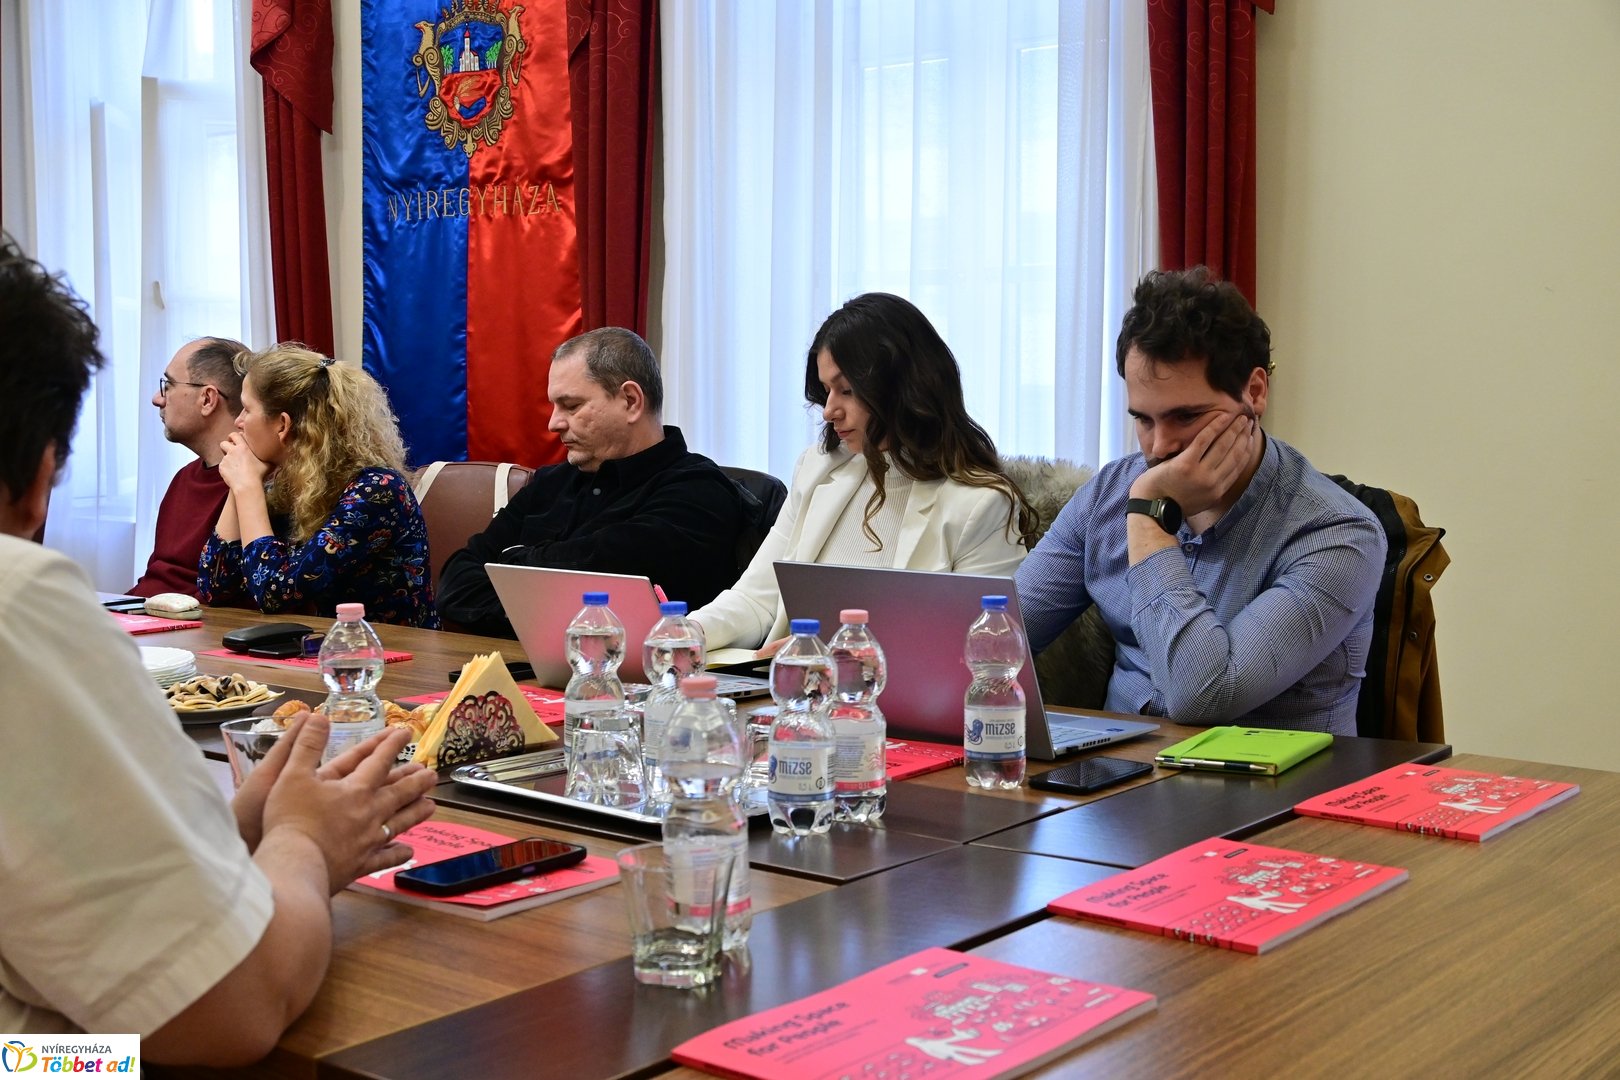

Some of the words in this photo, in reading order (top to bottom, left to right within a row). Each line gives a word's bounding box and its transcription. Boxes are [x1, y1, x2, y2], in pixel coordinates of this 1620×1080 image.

[985, 722, 1016, 735] mizse
[779, 760, 812, 775] mizse
[723, 1018, 803, 1049] Making
[778, 1019, 843, 1044] People
